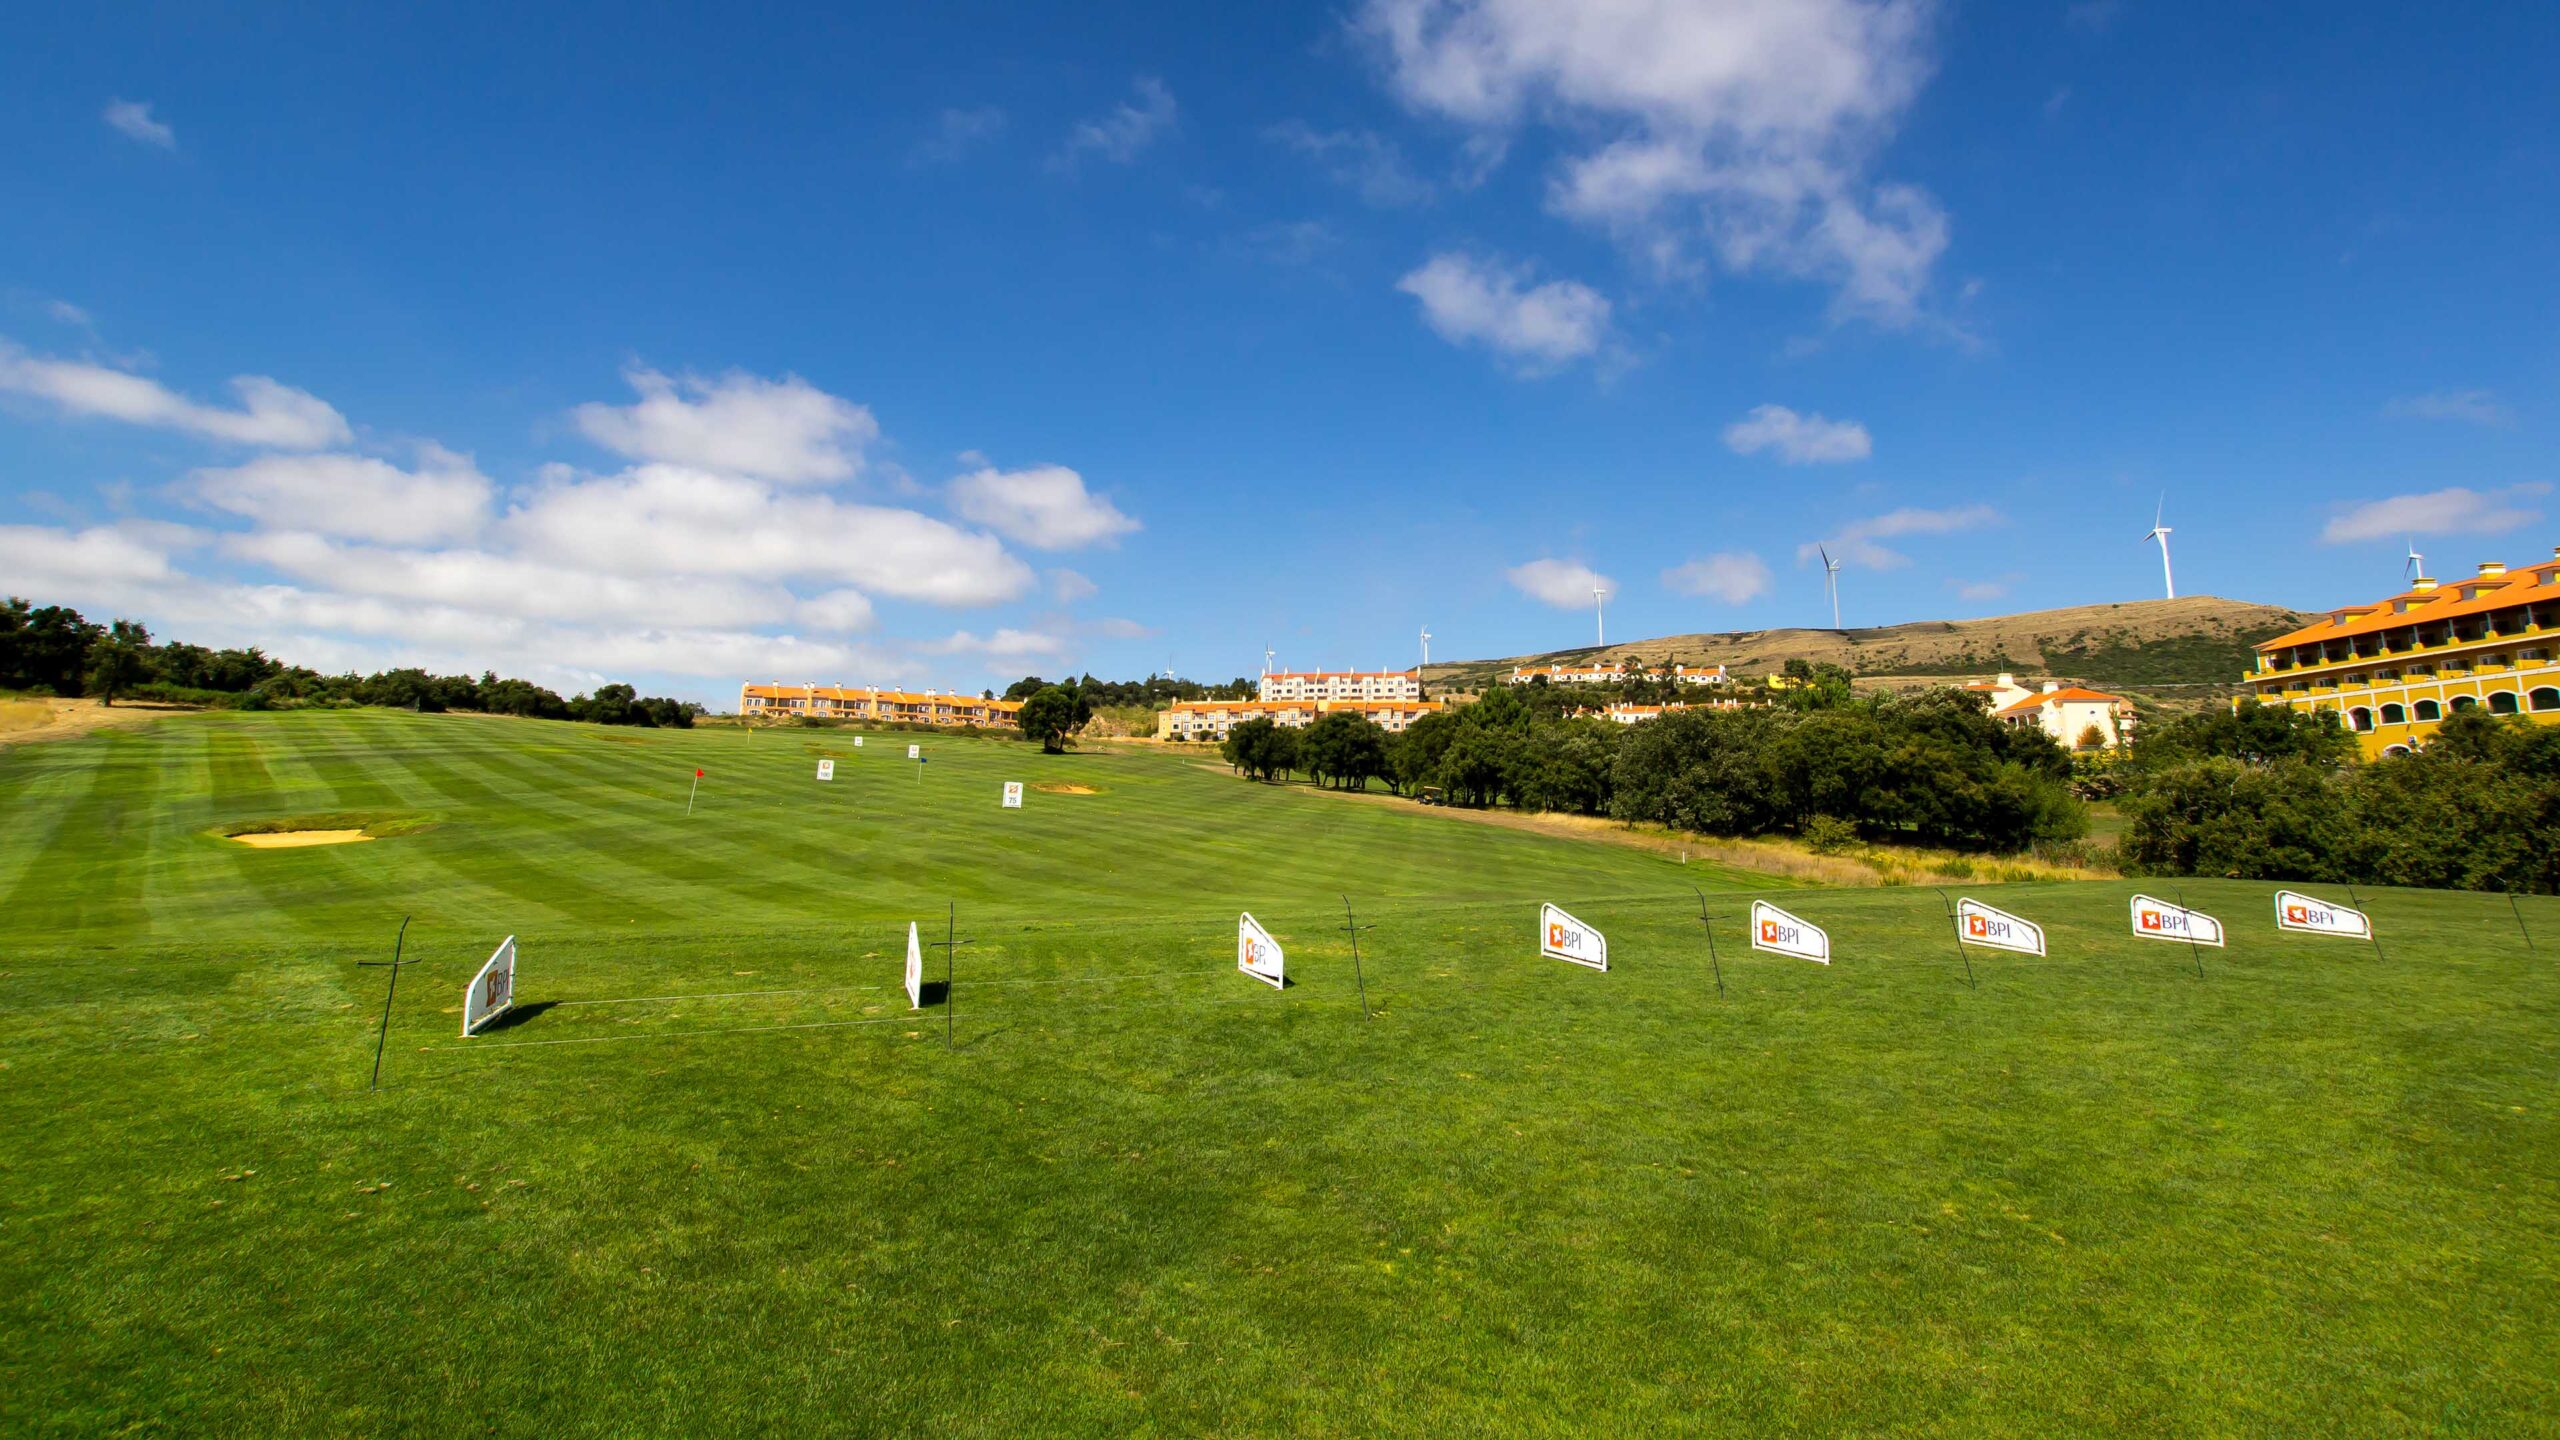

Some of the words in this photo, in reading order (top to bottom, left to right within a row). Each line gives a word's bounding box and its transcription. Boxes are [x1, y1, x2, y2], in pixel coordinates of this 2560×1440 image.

[1008, 796, 1017, 804] 75
[2162, 914, 2187, 931] BPI
[2308, 909, 2334, 925] BPI
[1778, 925, 1799, 945] BPI
[1987, 920, 2011, 938] BPI
[1564, 929, 1581, 950] BPI
